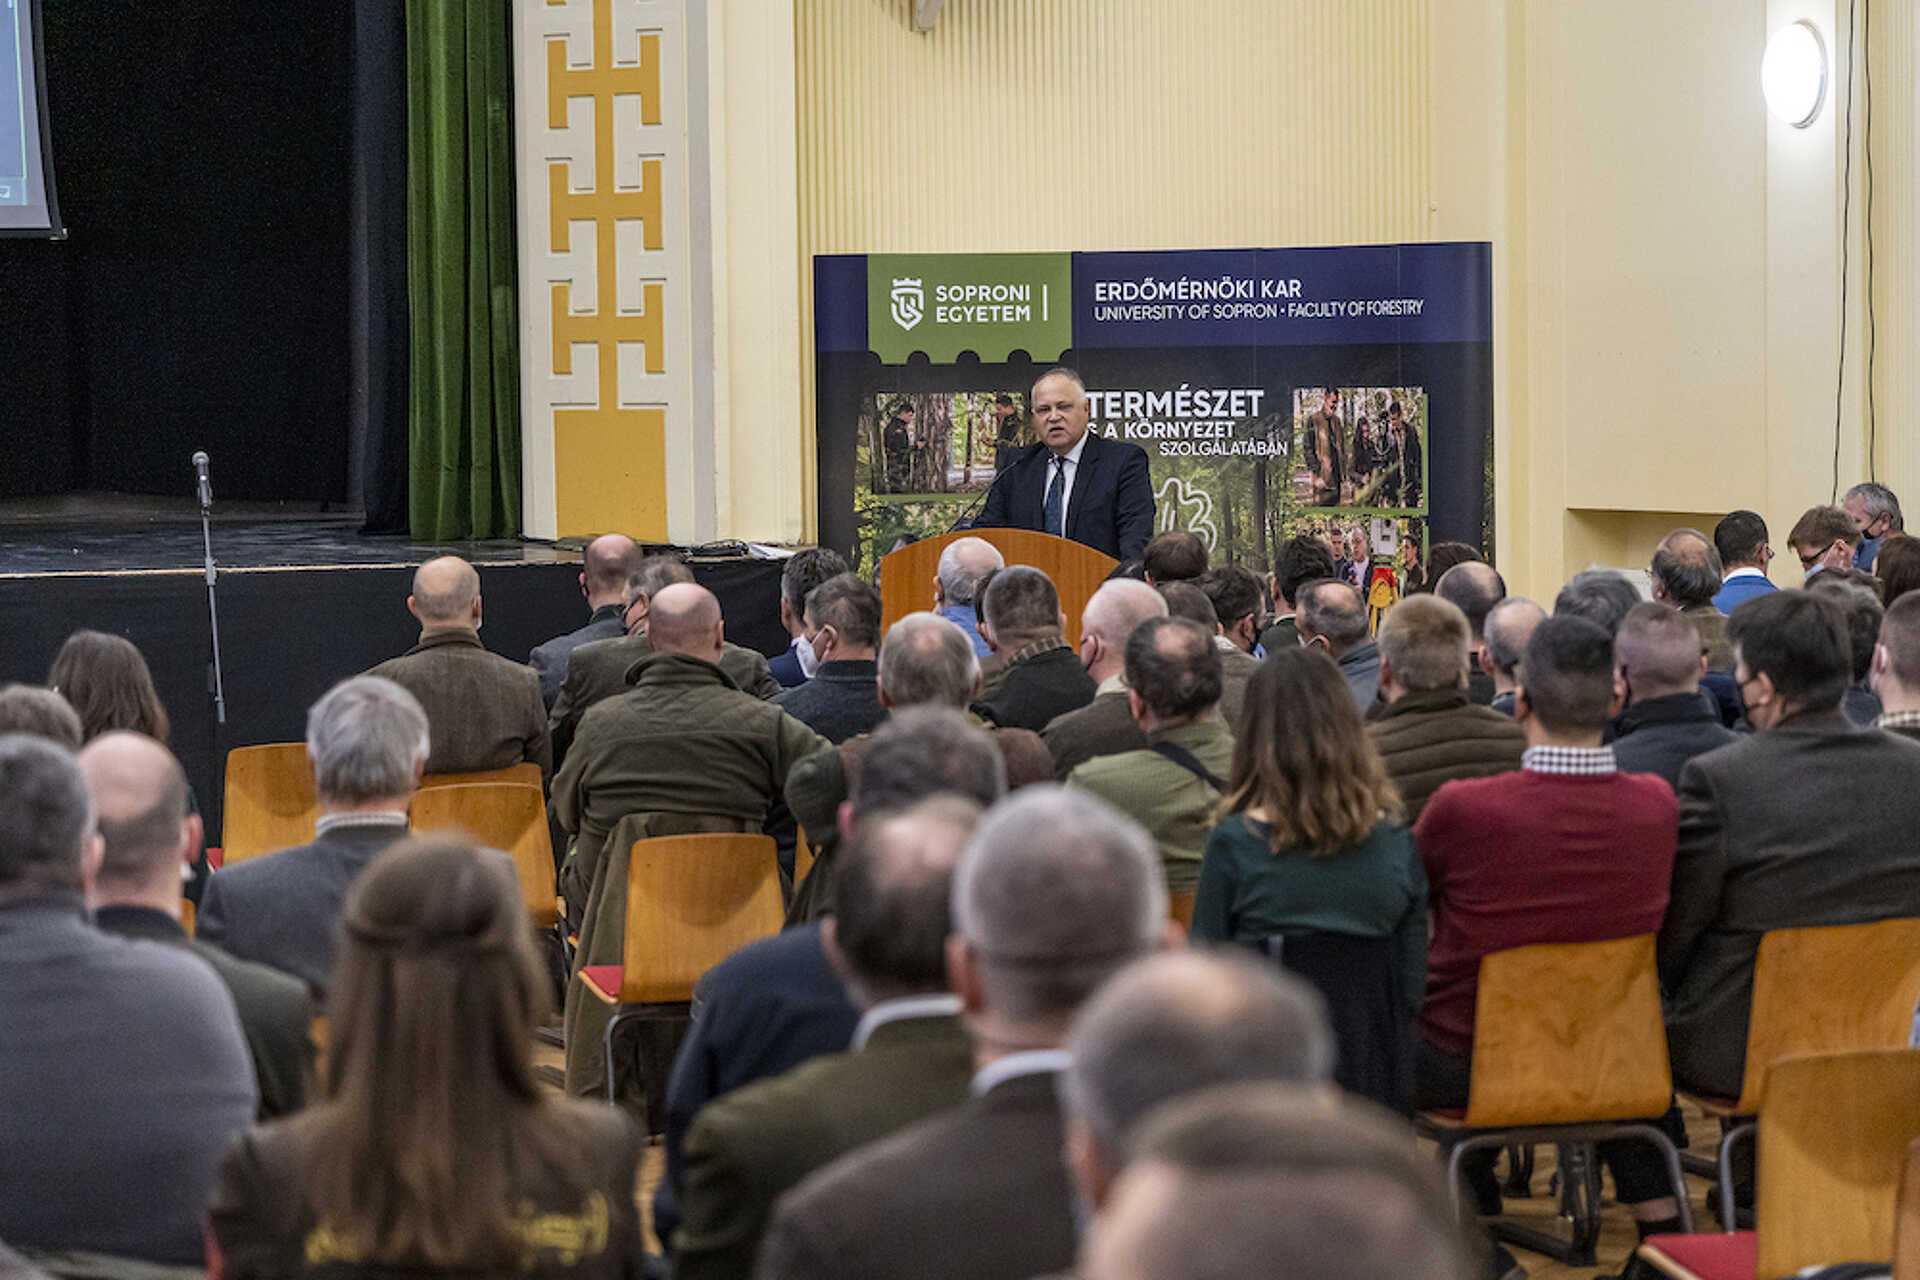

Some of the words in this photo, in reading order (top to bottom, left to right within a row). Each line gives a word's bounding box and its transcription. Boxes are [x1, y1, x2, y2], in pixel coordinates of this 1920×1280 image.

[935, 284, 1031, 302] SOPRONI
[1095, 276, 1254, 301] ERDŐMÉRNÖKI
[1261, 279, 1302, 298] KAR
[935, 304, 1031, 323] EGYETEM
[1094, 304, 1185, 321] UNIVERSITY
[1188, 304, 1210, 320] OF
[1213, 302, 1278, 320] SOPRON
[1288, 301, 1347, 318] FACULTY
[1348, 301, 1366, 317] OF
[1366, 299, 1424, 316] FORESTRY
[1085, 383, 1264, 418] TERMÉSZET
[1104, 422, 1119, 439] A
[1124, 418, 1236, 439] KÖRNYEZET
[1159, 437, 1288, 456] SZOLGÁLATÁBAN
